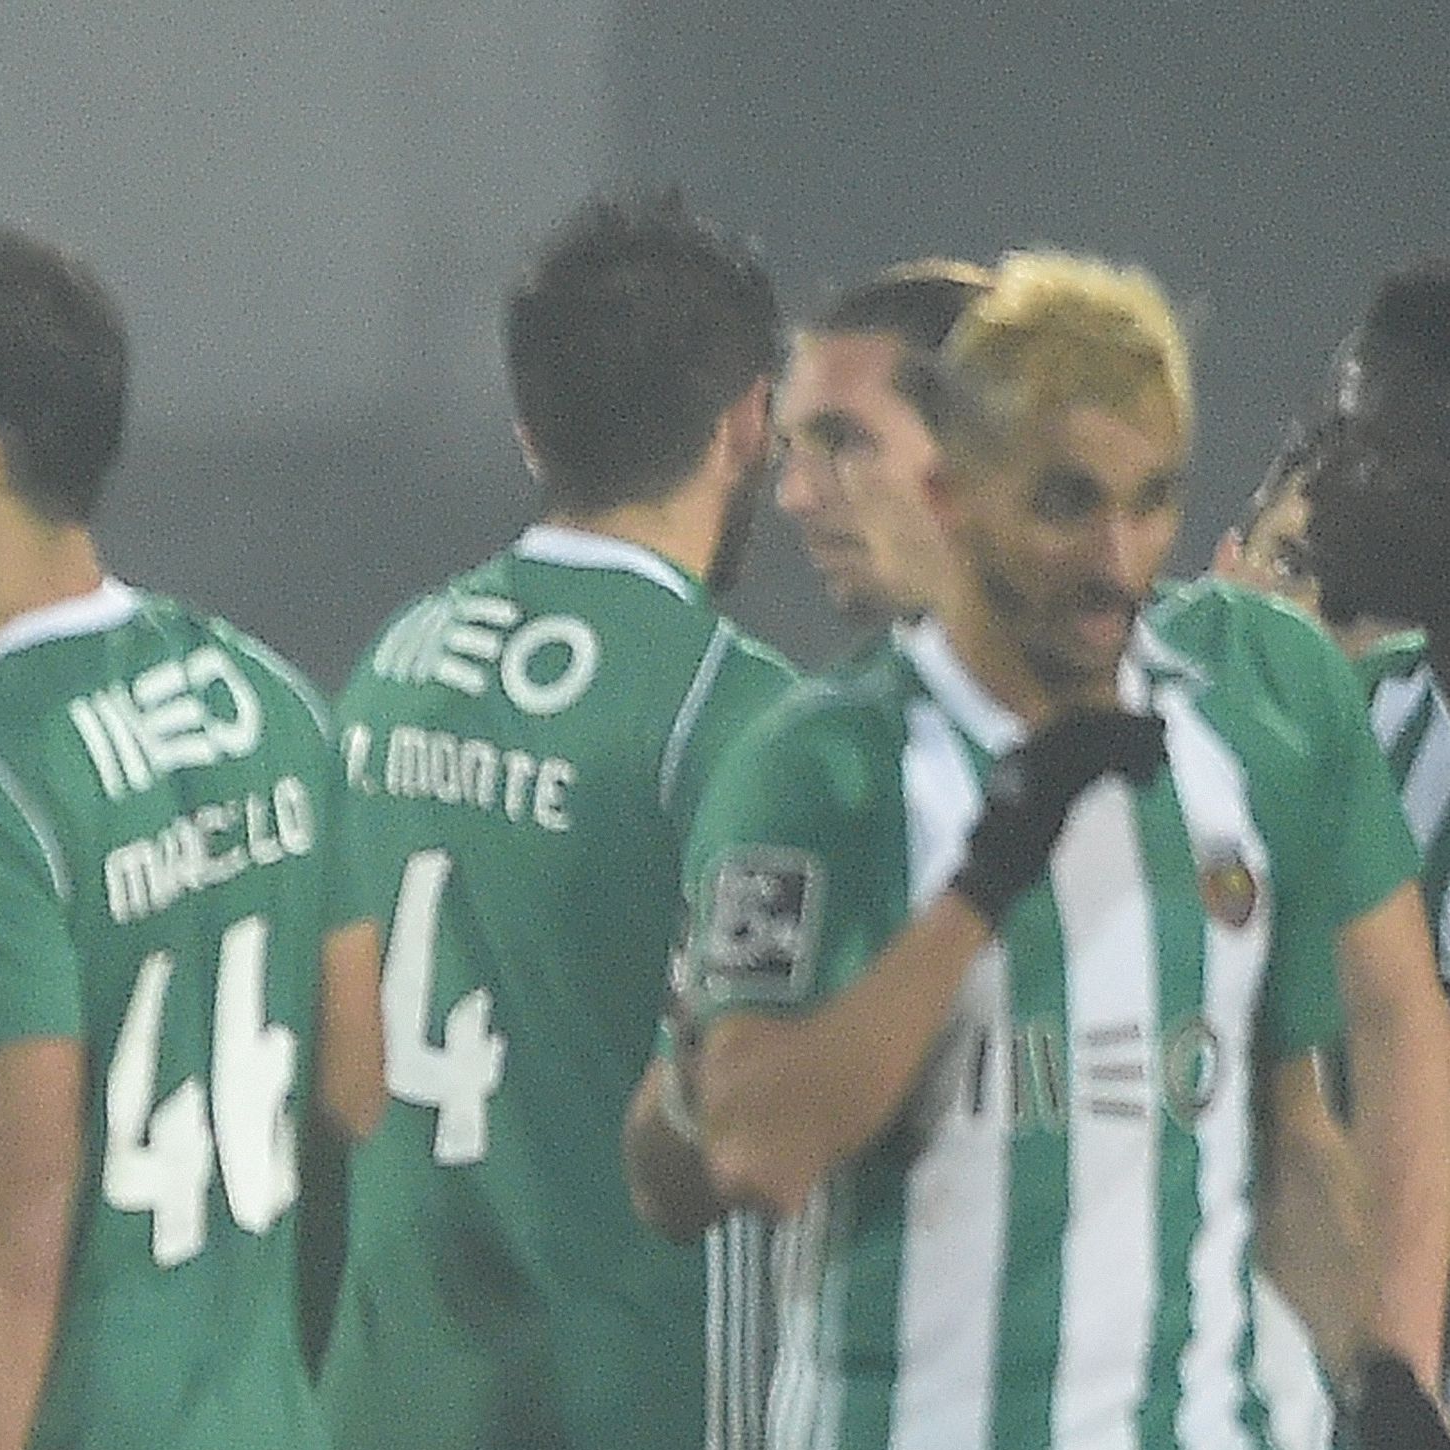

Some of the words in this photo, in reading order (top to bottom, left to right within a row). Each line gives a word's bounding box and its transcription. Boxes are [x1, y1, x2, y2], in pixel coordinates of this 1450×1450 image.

[371, 590, 601, 716] MEO
[385, 724, 578, 832] MONTE
[380, 847, 506, 1167] 4
